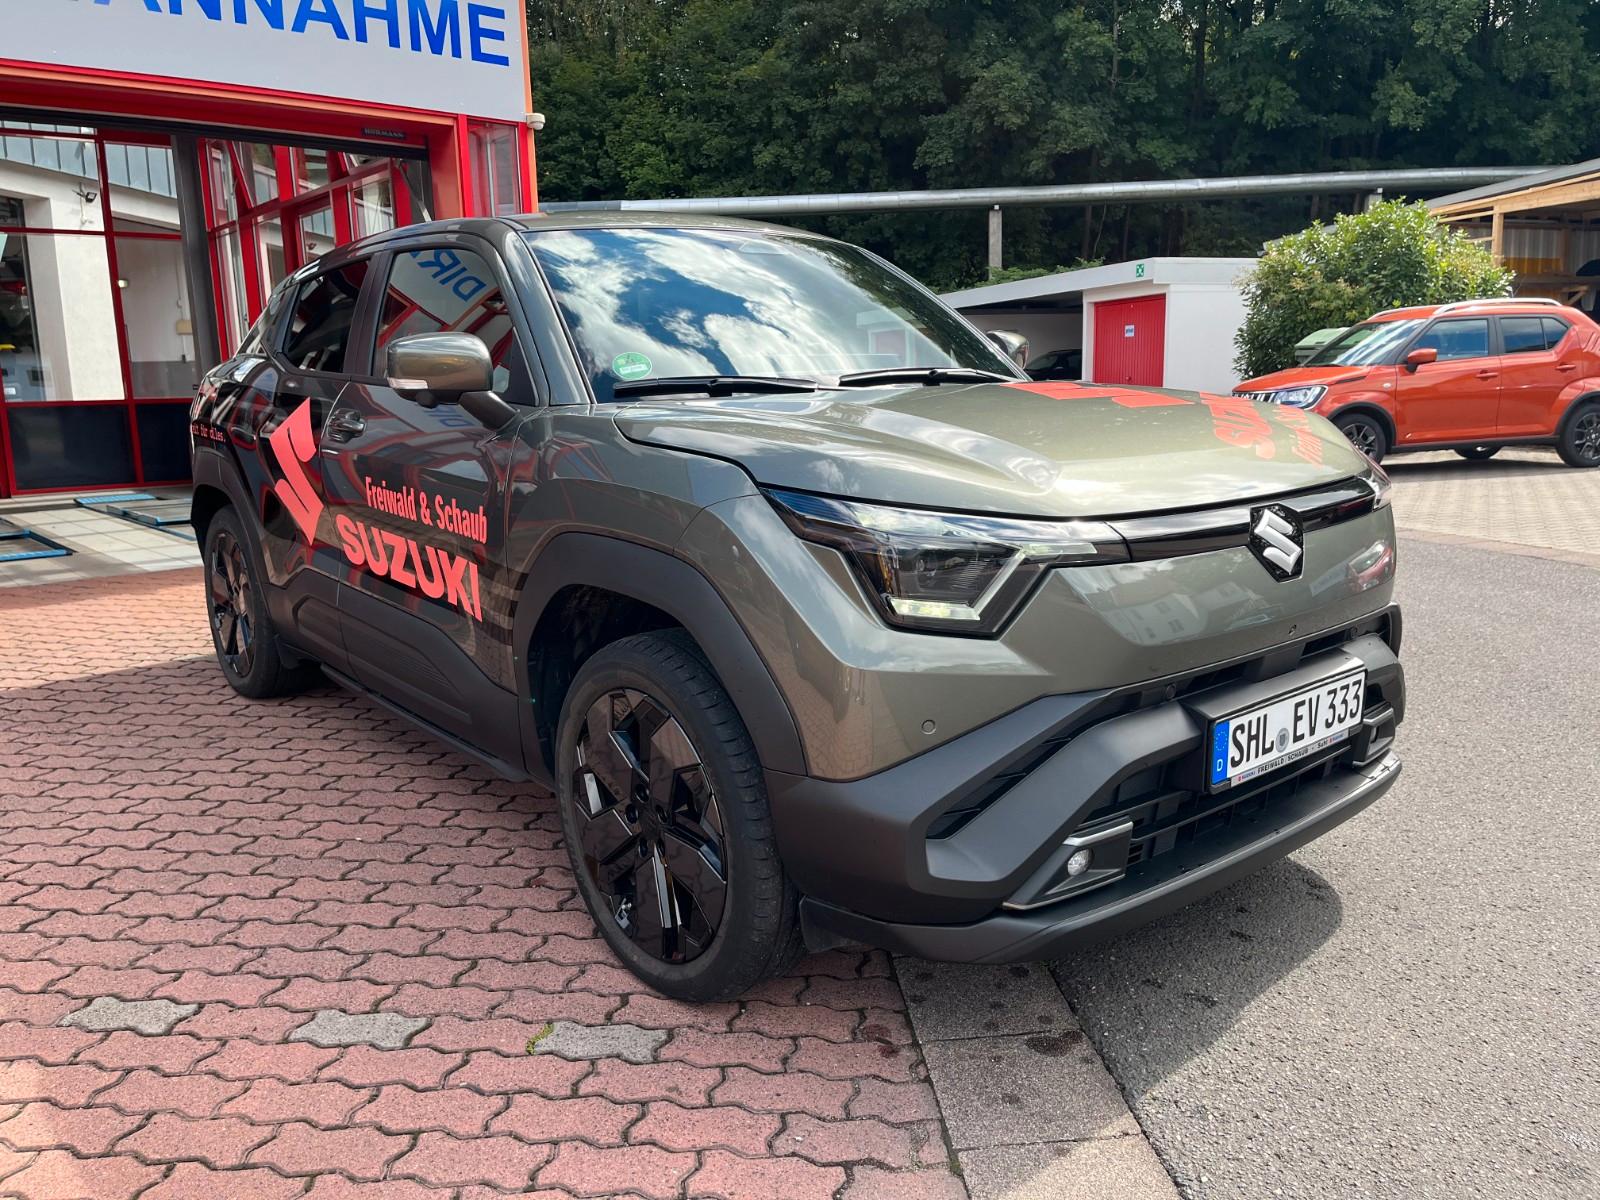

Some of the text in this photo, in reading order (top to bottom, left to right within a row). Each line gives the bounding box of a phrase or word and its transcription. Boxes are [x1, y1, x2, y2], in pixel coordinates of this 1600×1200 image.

[94, 0, 509, 66] NAHME
[365, 476, 488, 544] Freiwald & Schaub
[335, 513, 482, 622] SUZUKI
[1230, 678, 1362, 768] SHL EV 333
[1216, 758, 1223, 772] D
